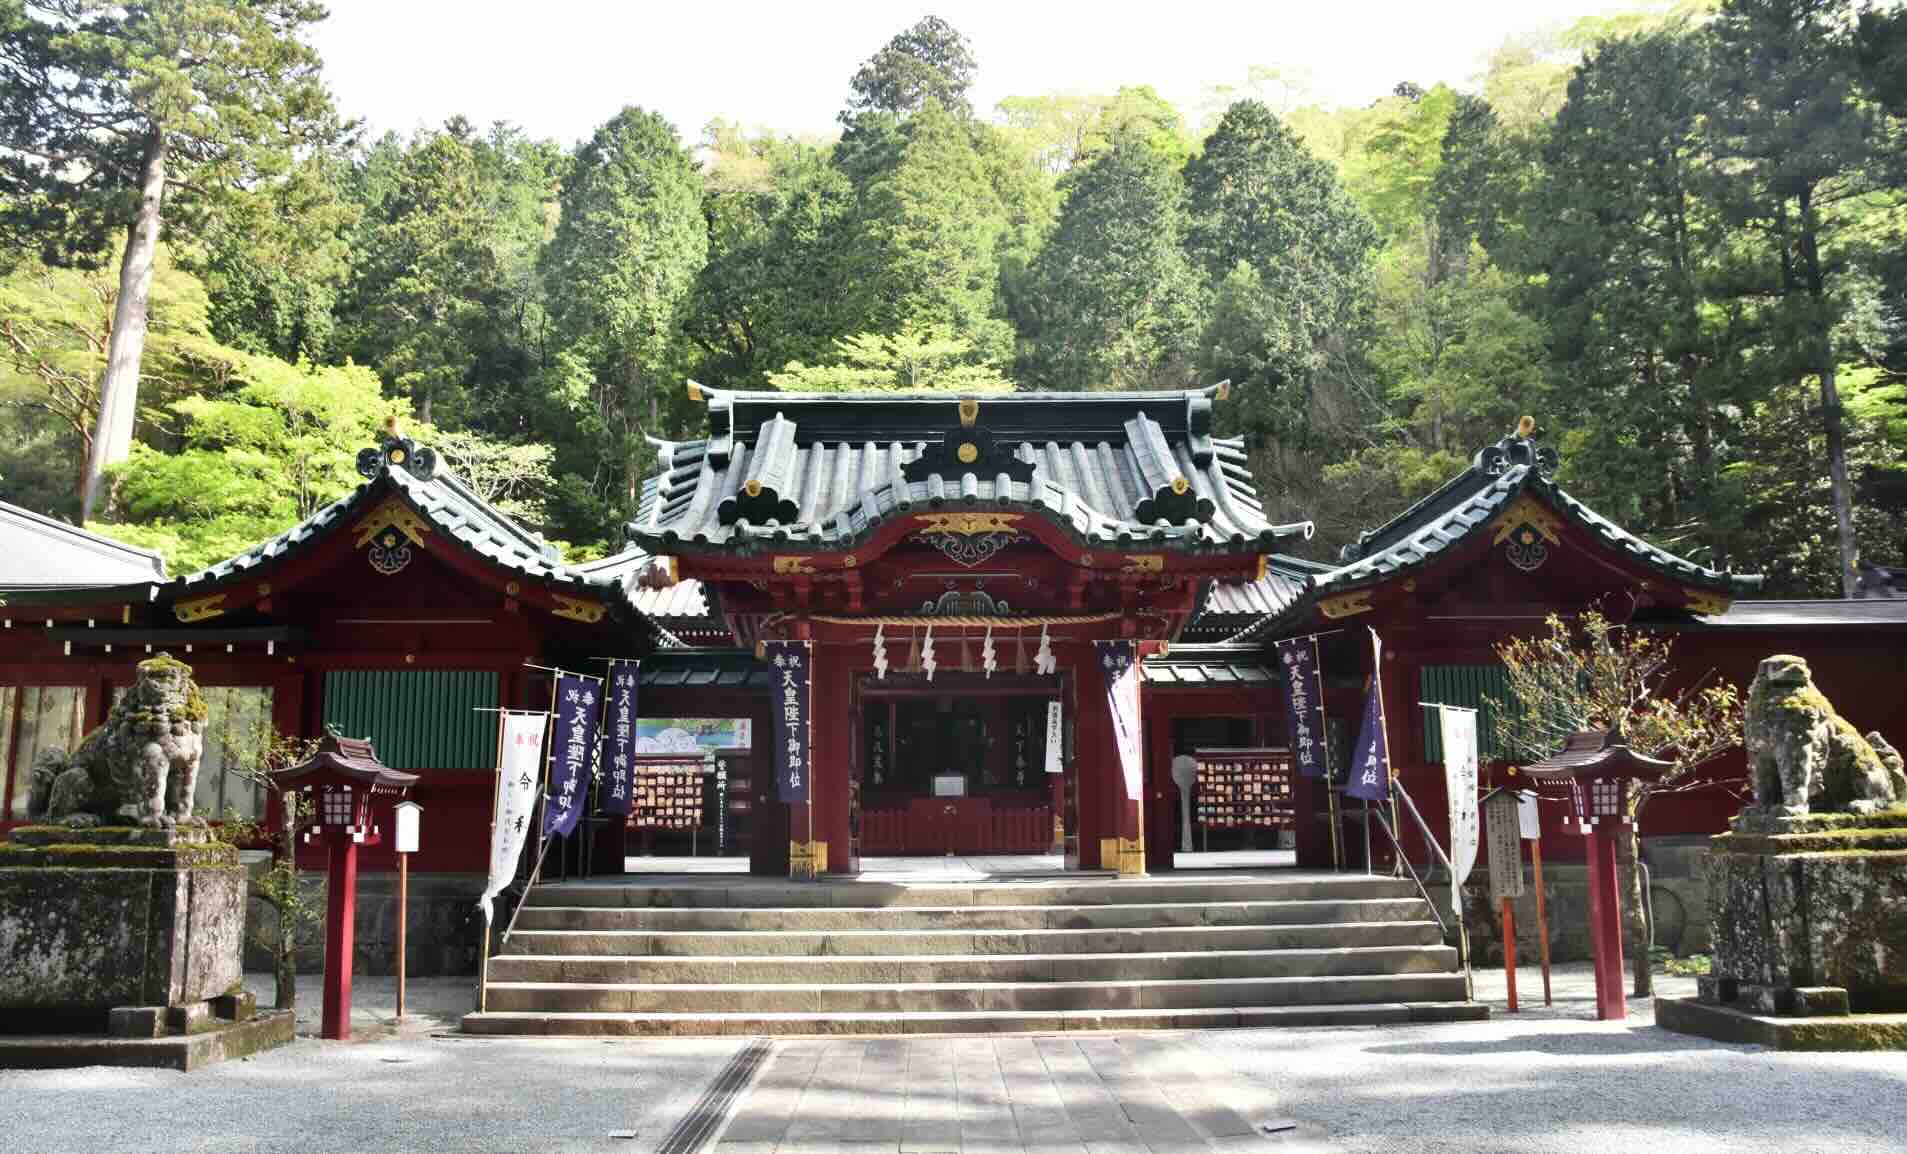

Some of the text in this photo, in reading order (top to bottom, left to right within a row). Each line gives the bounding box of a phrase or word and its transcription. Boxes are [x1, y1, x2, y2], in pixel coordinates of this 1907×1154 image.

[773, 654, 801, 668] 奉祝
[782, 670, 802, 788] 天皇陛下御即位
[1289, 665, 1313, 765] 天皇陛下御即位
